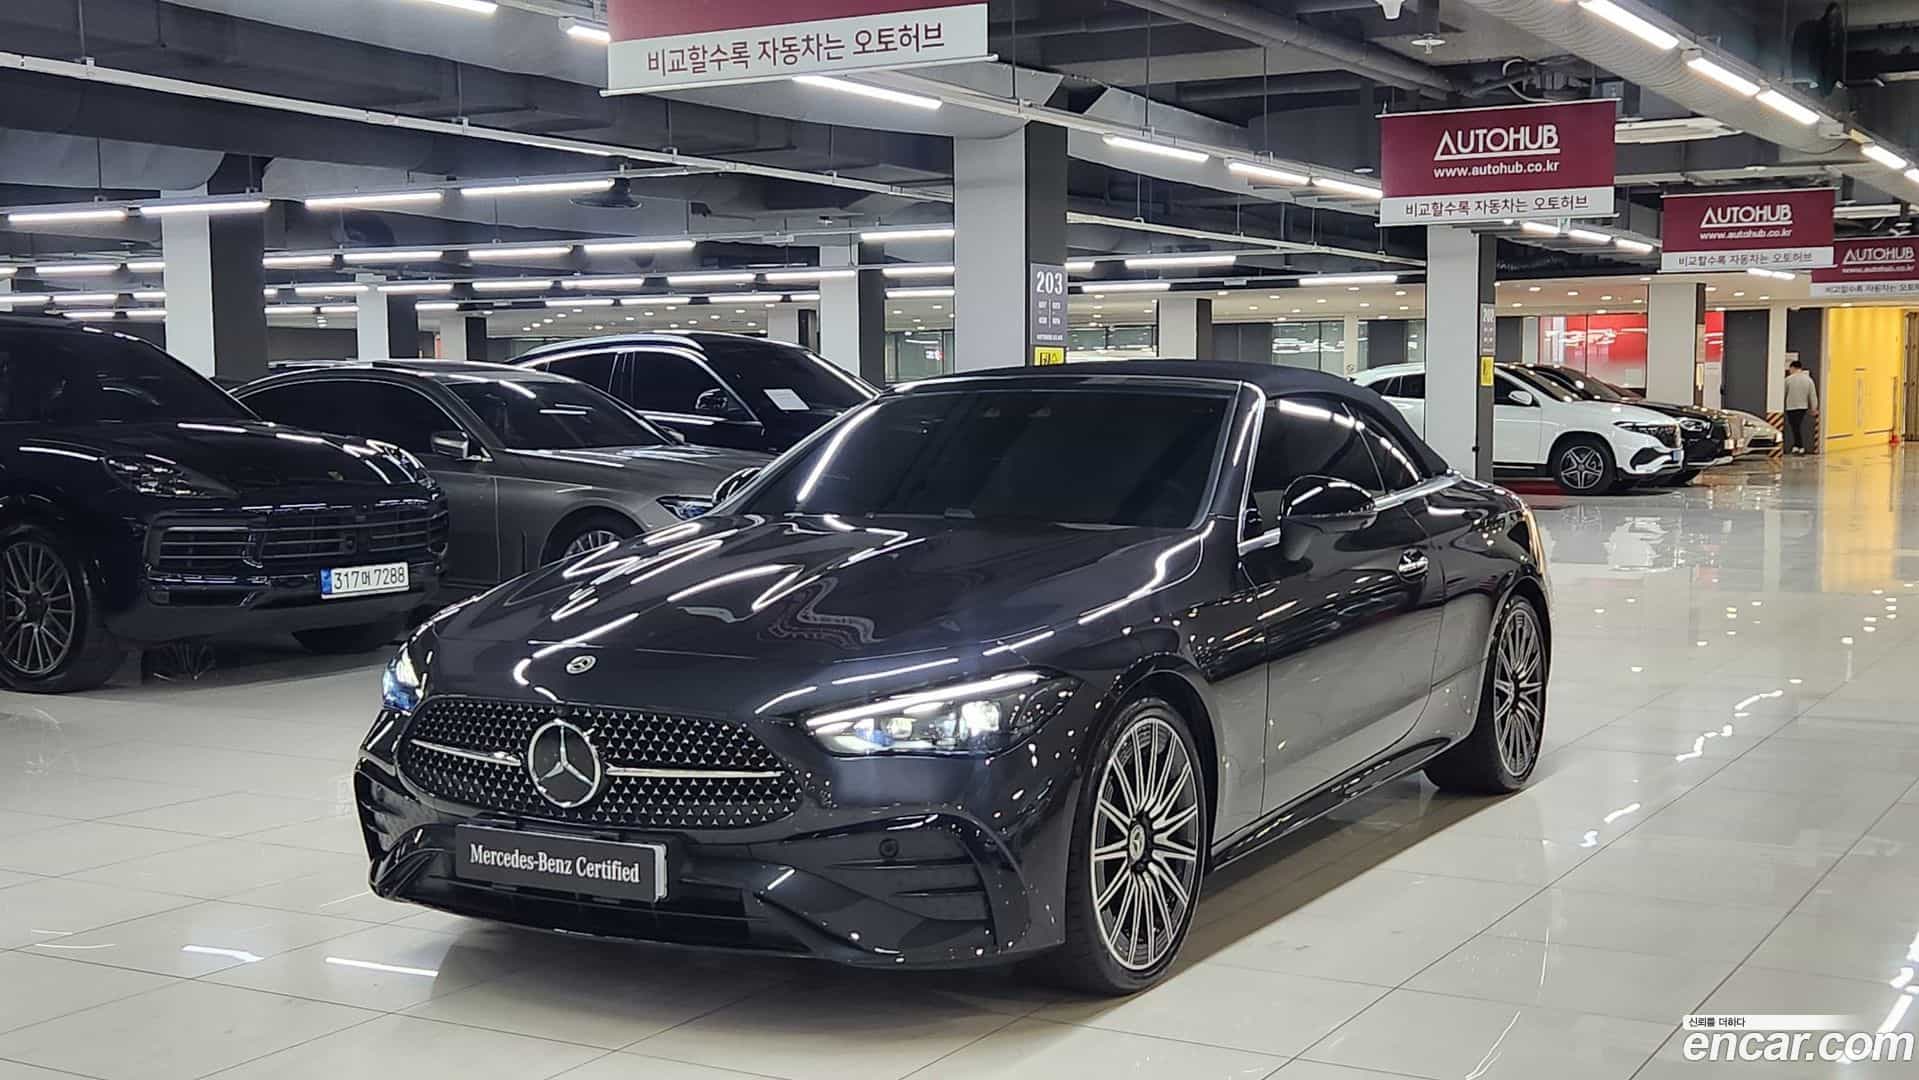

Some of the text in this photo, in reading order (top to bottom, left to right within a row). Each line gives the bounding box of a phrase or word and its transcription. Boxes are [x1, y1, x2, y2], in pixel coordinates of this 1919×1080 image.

[647, 22, 944, 75] 비교할수록 자동차는 오토허브
[1434, 125, 1560, 160] AUTOHUB
[1434, 160, 1559, 178] www.autohub.co.kr
[1406, 195, 1589, 217] 비교할수록 자동차는 오토허브
[1700, 205, 1792, 228] AUTOHUB
[1842, 247, 1915, 264] AUTOHUB
[1036, 271, 1063, 295] 203
[470, 843, 639, 883] Mercedes-Benz Certified
